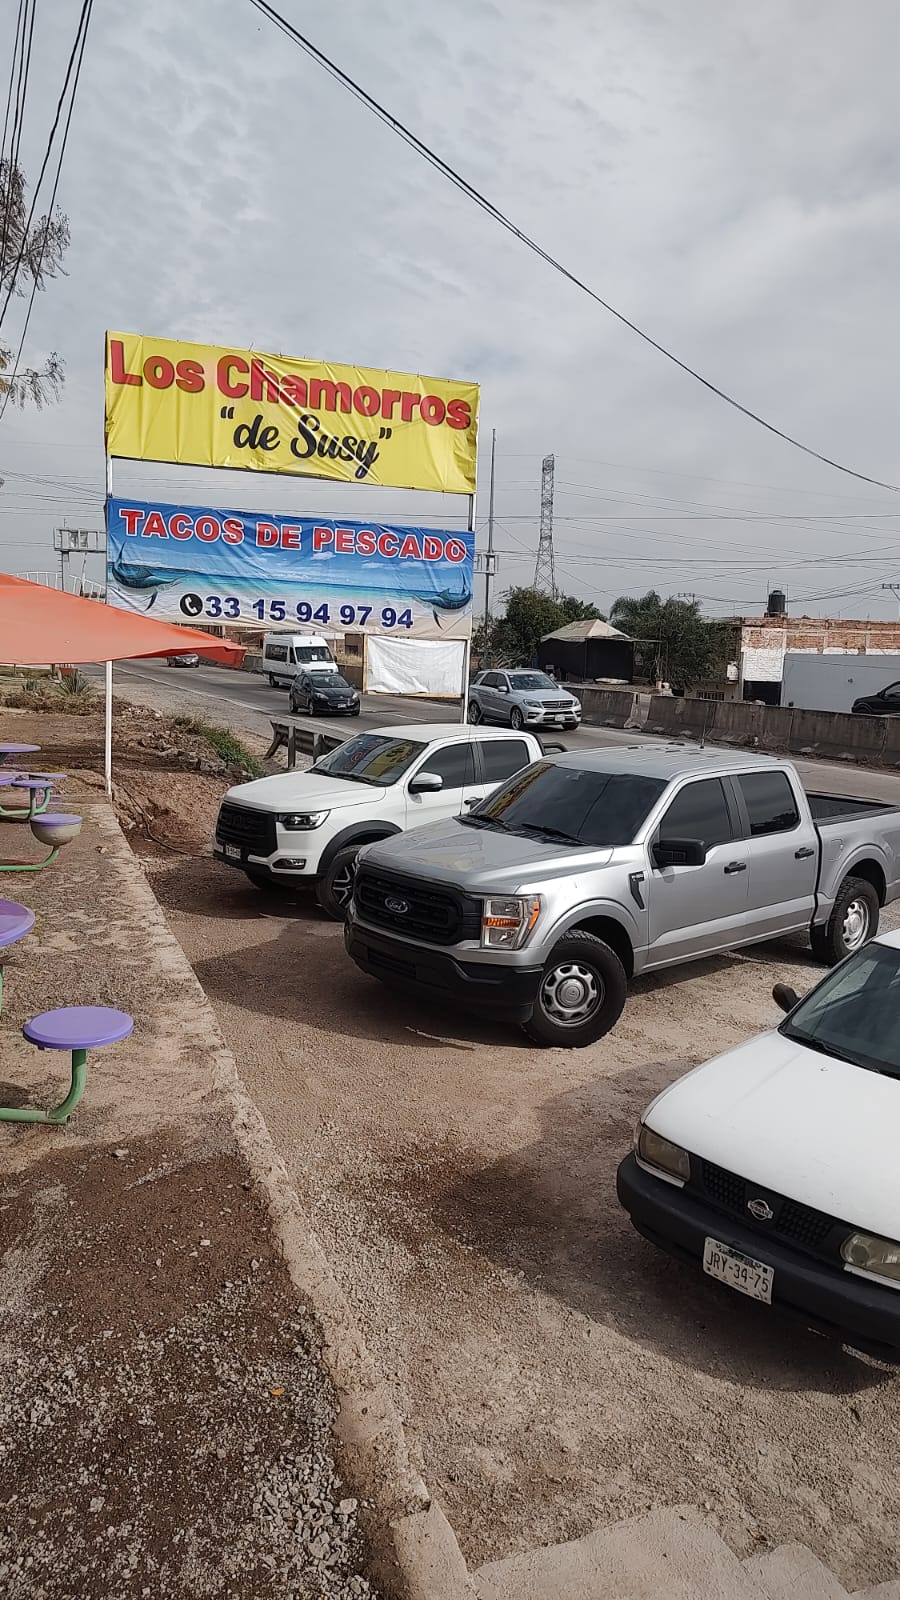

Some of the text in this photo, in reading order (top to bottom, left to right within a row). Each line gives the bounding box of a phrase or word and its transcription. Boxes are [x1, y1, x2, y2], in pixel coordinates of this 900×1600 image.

[110, 340, 472, 431] Los Chamorros
[119, 508, 467, 563] TACOS DE PESCADO
[205, 596, 413, 629] 33 15 94 97 94
[706, 1250, 769, 1293] JRY-34-75
